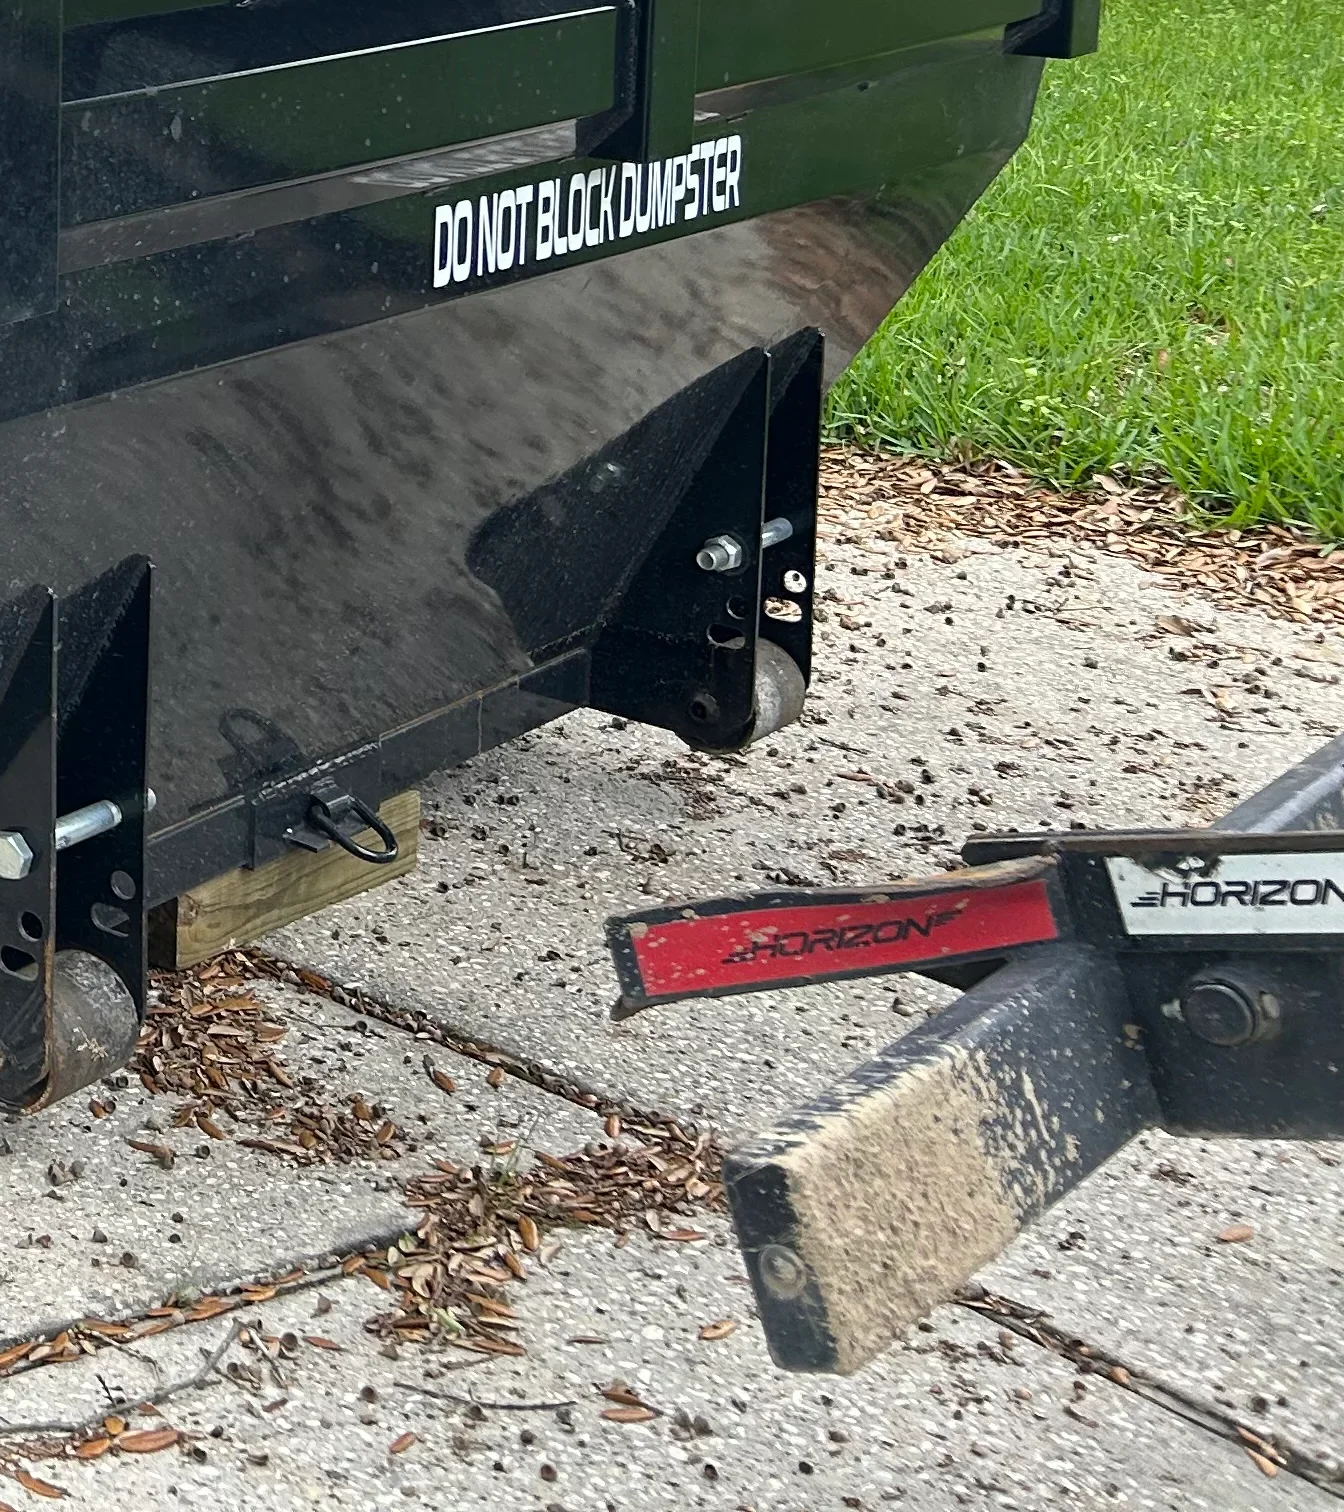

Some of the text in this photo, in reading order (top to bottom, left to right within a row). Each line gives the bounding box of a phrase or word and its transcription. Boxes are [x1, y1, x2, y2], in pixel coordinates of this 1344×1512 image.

[433, 135, 742, 288] DO NOT BLOCK DUMPSTER
[752, 914, 934, 958] HORIZON
